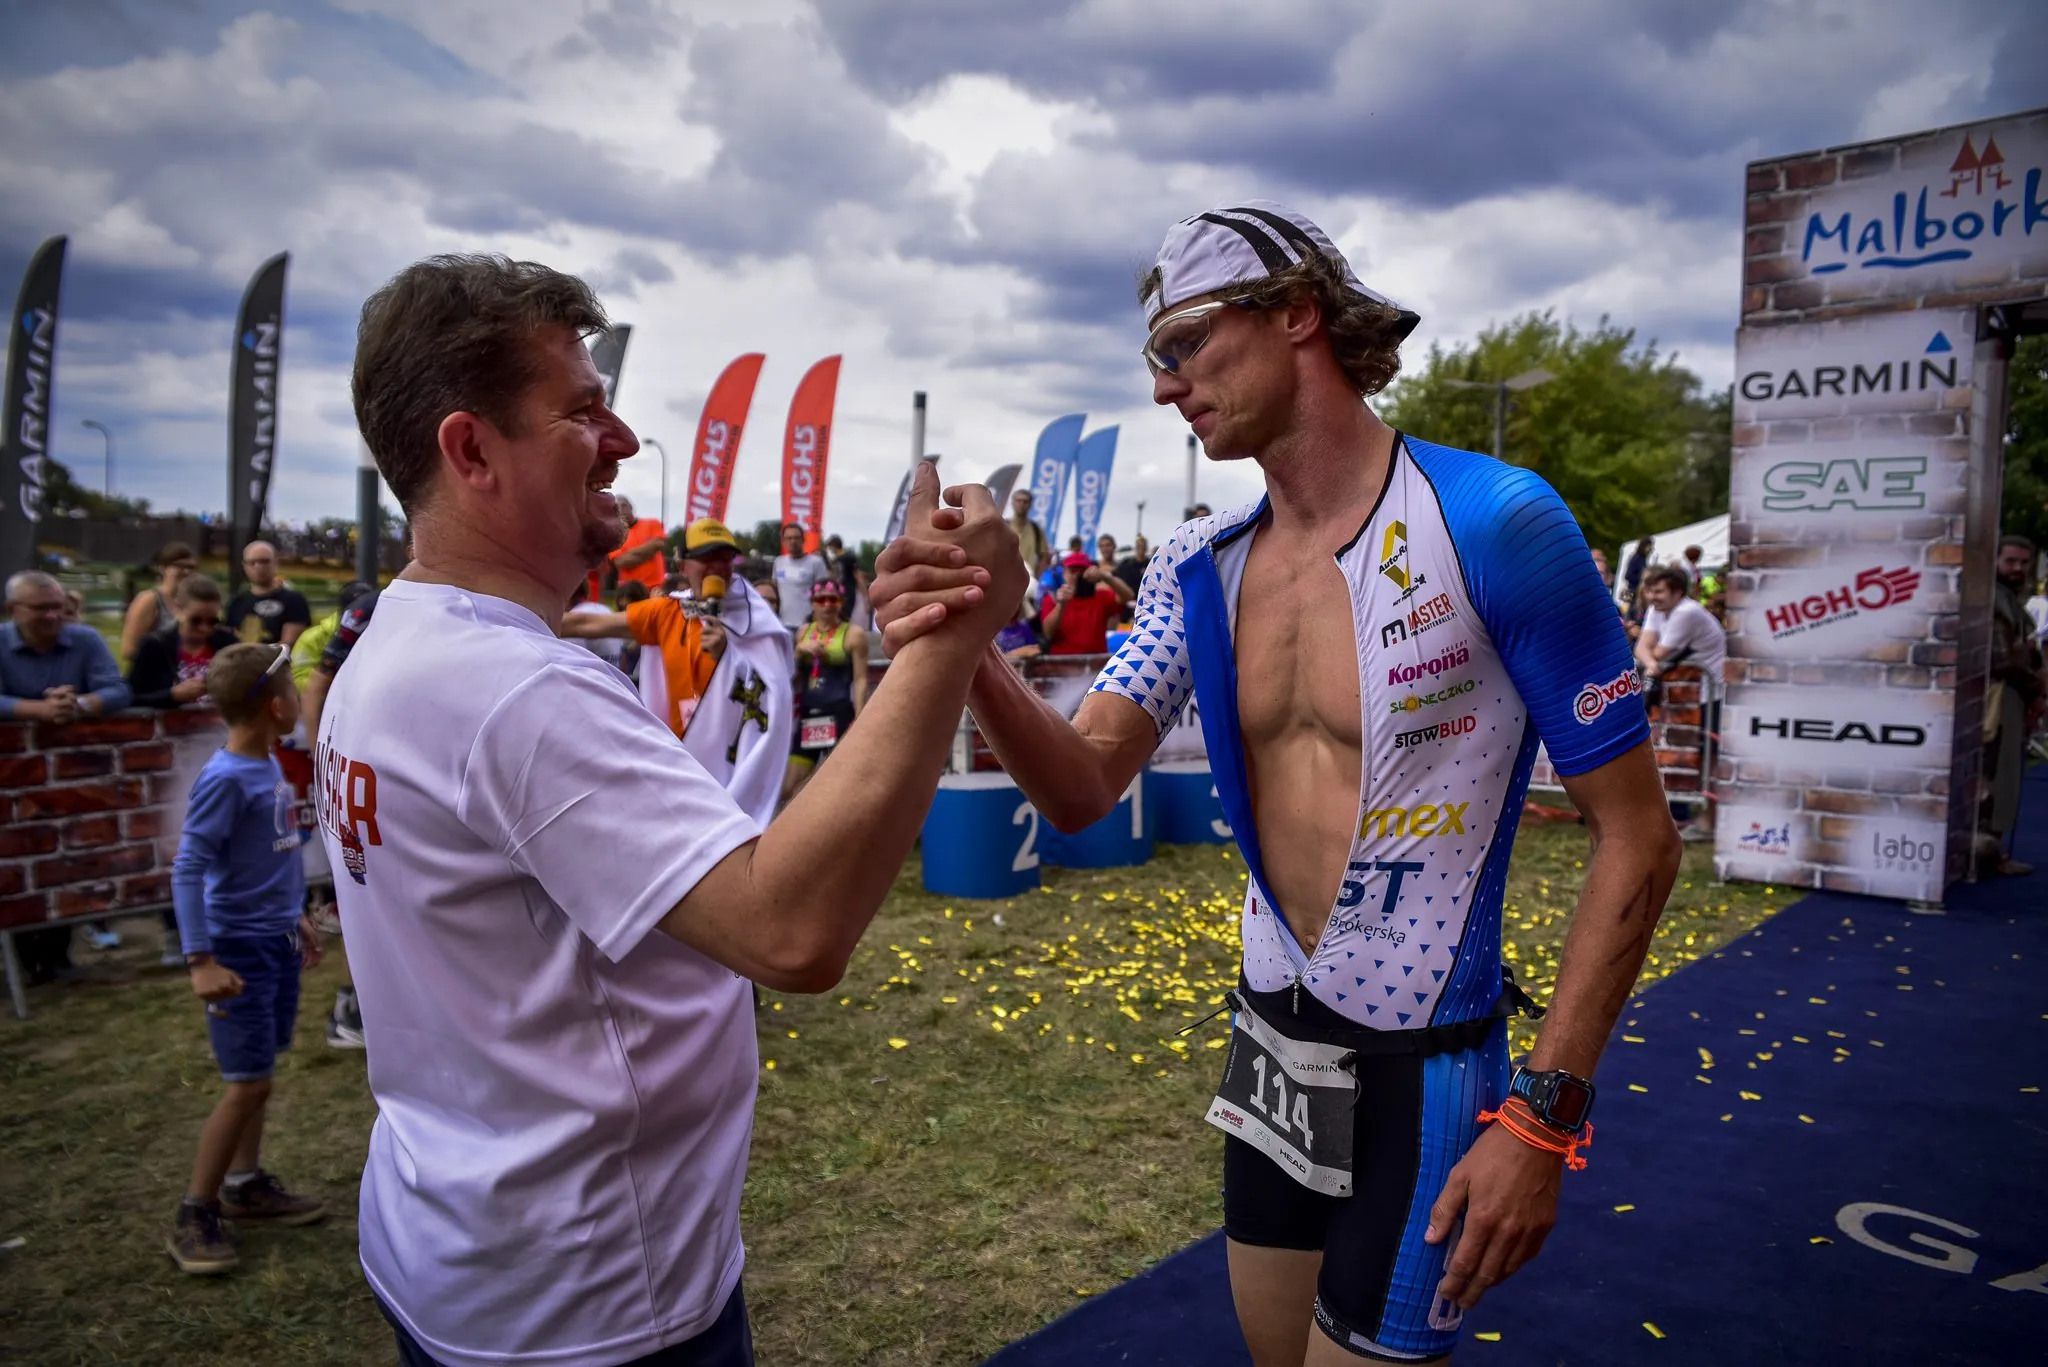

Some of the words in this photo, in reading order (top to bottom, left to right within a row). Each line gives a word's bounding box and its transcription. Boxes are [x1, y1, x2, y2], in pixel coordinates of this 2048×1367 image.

[1803, 167, 2048, 263] Malbork
[1741, 358, 1957, 401] GARMIN
[19, 307, 52, 523] GARMIN
[1763, 456, 1927, 512] SAE
[1765, 566, 1905, 632] HIGH5
[1388, 647, 1469, 686] Korona
[1441, 640, 1468, 655] SKLEPY
[1395, 715, 1477, 748] stawBUD
[1750, 716, 1926, 747] HEAD
[1118, 771, 1143, 839] 1
[1012, 801, 1040, 872] 2
[1874, 832, 1935, 862] labo
[1330, 915, 1406, 943] Brokerska
[1292, 1061, 1340, 1074] GARMIN
[1221, 1108, 1244, 1126] HIGH5
[1250, 1054, 1313, 1150] 114
[1280, 1148, 1307, 1174] HEAD
